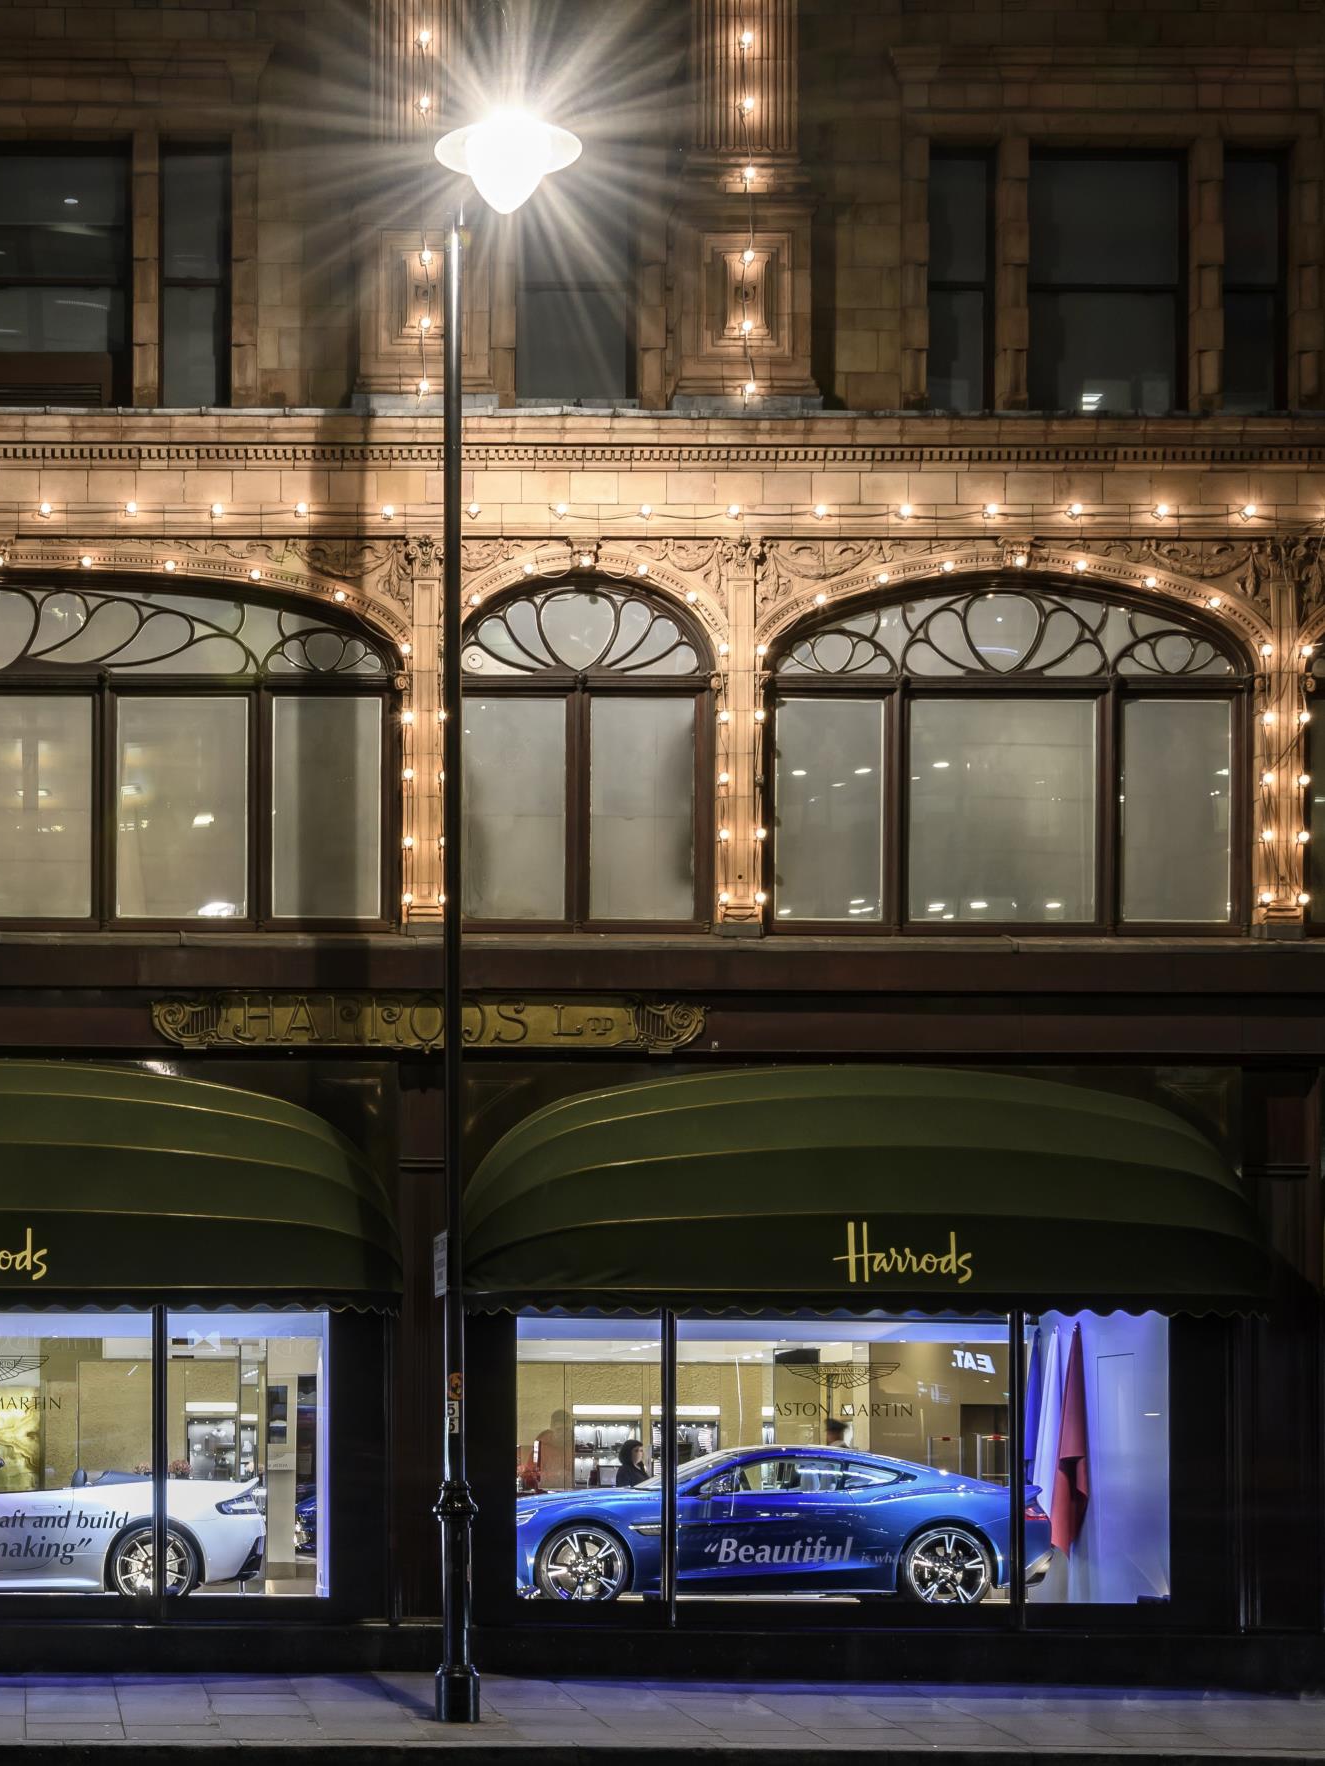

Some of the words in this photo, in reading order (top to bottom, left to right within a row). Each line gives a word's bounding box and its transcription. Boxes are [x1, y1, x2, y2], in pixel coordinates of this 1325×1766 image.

[832, 1221, 973, 1284] Harrods
[773, 1402, 830, 1417] ASTON
[839, 1403, 913, 1417] MARTIN
[33, 1511, 72, 1529] and
[76, 1511, 128, 1529] build
[860, 1551, 872, 1563] is
